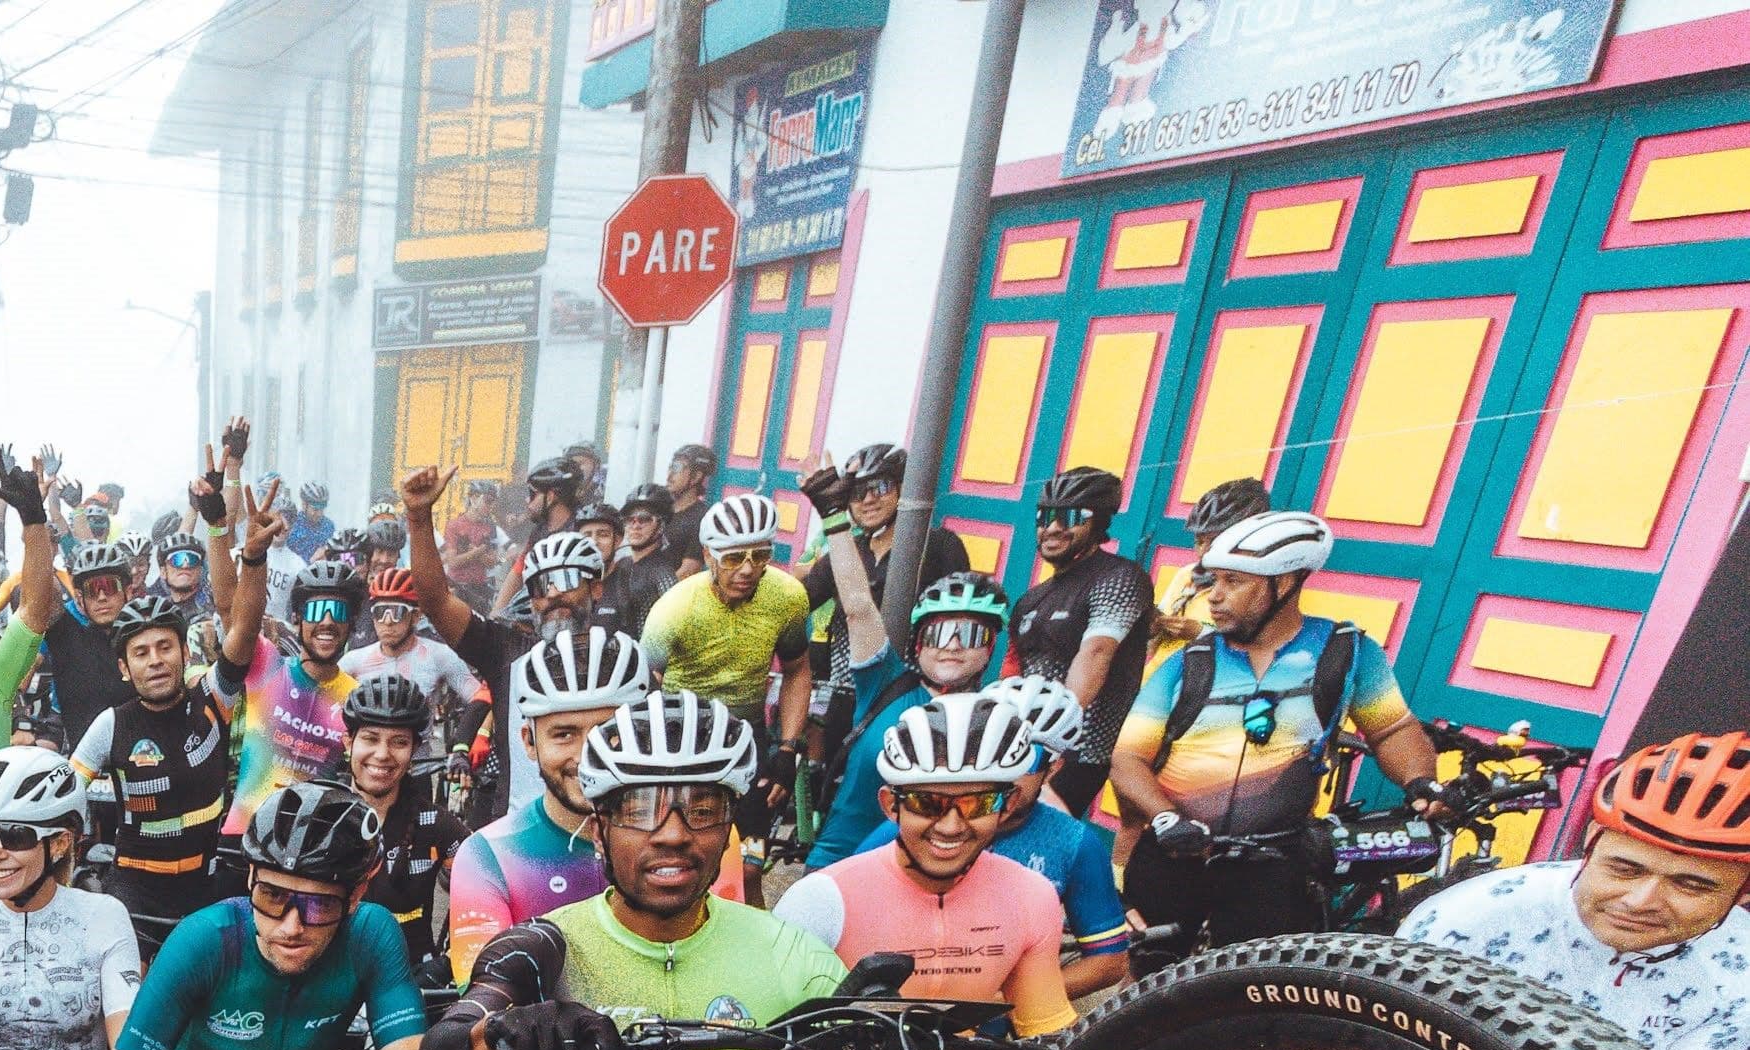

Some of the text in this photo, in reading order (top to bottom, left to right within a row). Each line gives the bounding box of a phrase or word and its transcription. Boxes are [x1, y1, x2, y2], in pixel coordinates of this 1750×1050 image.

[1076, 134, 1105, 166] Cel.
[1118, 119, 1151, 157] 311
[1153, 112, 1187, 151] 661
[1189, 107, 1218, 144] 51
[1217, 100, 1249, 139] 58
[1259, 89, 1300, 132] 311
[1303, 77, 1350, 125] 341
[1352, 69, 1383, 116] 11
[1386, 60, 1421, 108] 70
[617, 227, 720, 276] PARE
[273, 705, 325, 737] PACHO
[1356, 830, 1410, 850] 566
[1245, 984, 1362, 1015] GROUND
[304, 1013, 342, 1030] KFT
